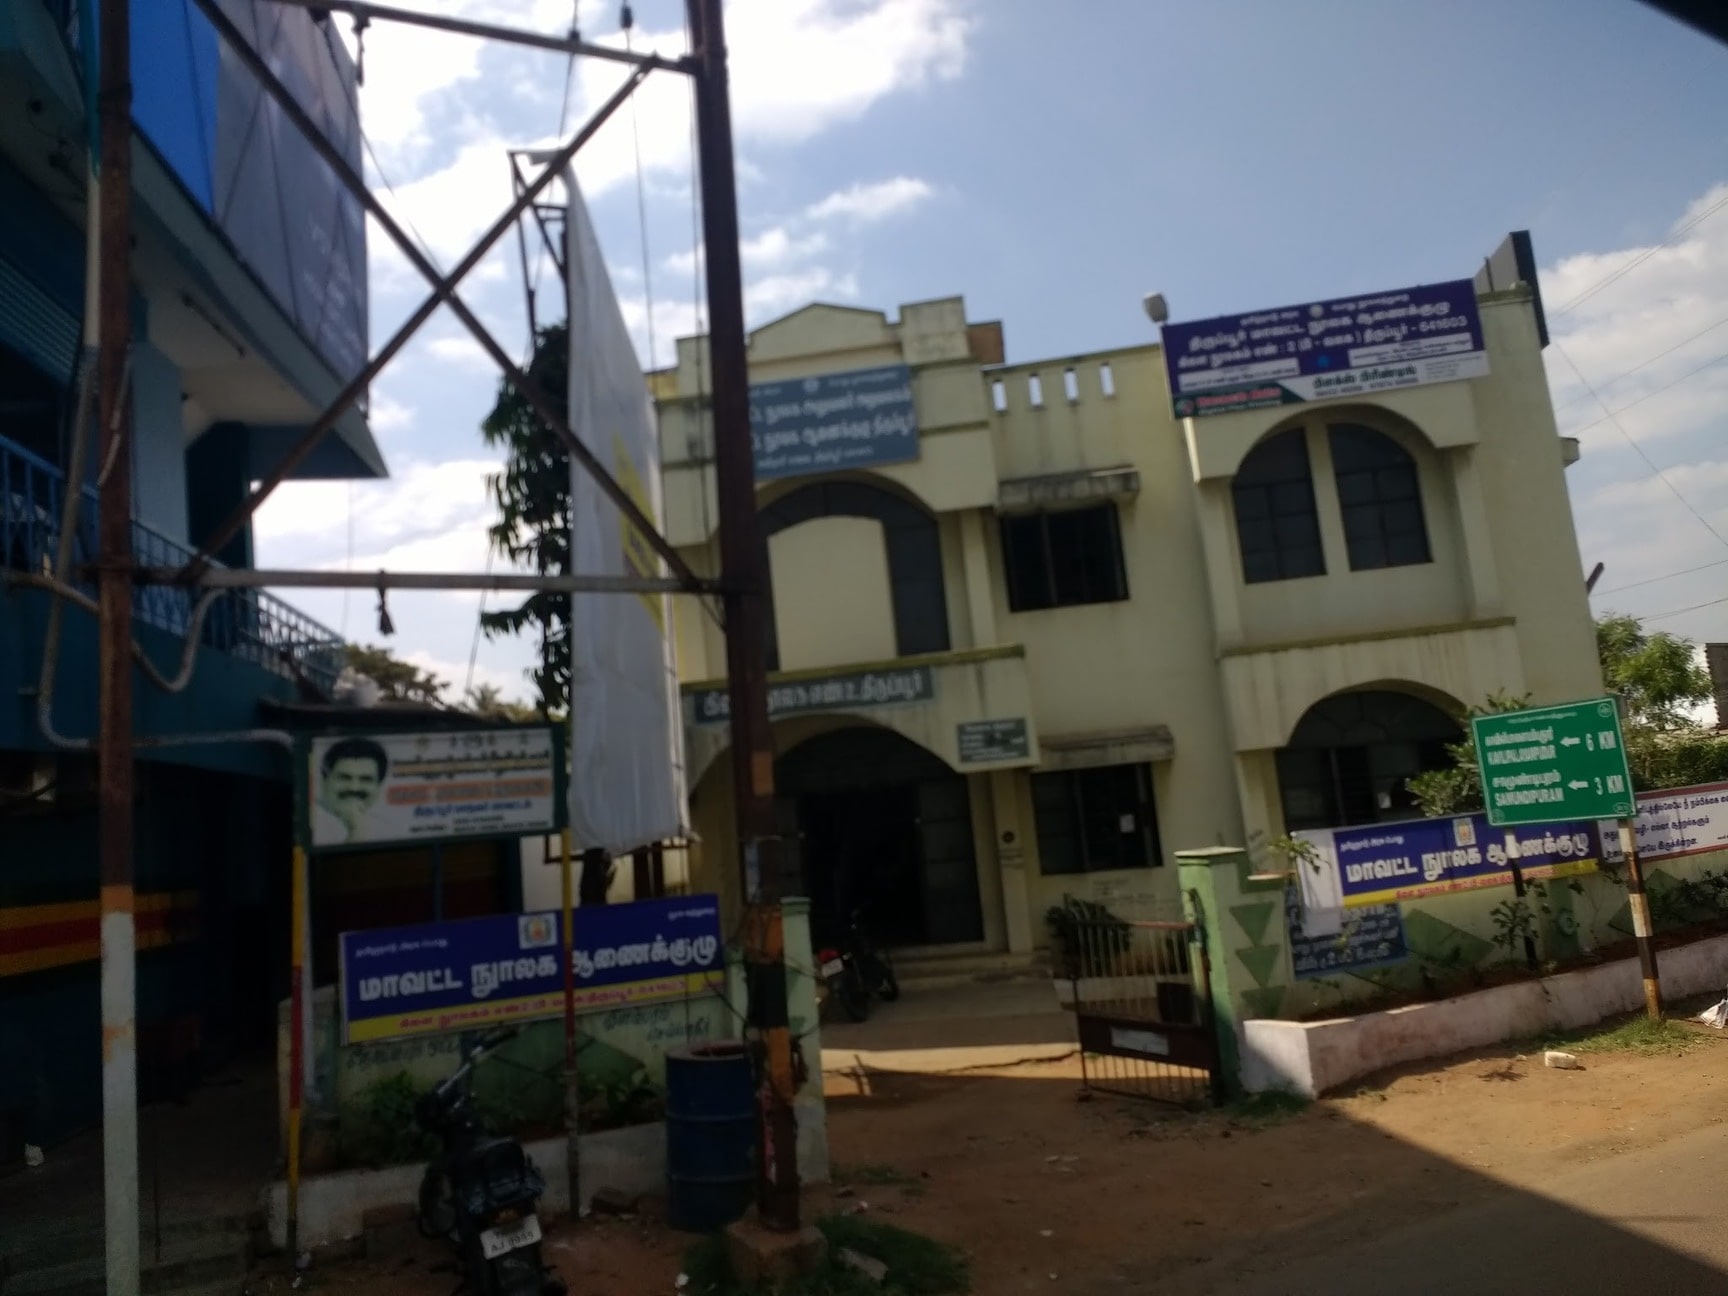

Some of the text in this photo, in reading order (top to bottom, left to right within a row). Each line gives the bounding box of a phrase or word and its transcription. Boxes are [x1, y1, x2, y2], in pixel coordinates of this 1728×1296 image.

[1189, 302, 1450, 351] திருப்பூர் மாவட்ட நூலக ஆணைக்குழு
[1178, 355, 1207, 368] கிளை
[1209, 348, 1252, 368] நூலகம்
[1363, 325, 1408, 343] திருப்பூர்
[1585, 730, 1616, 752] 6 KM
[1594, 774, 1624, 796] 3 KM
[1346, 857, 1418, 882] மாவட்ட
[1421, 847, 1482, 881] நூலக
[359, 935, 716, 1000] மாவட்ட நூலக ஆணைக்குழு
